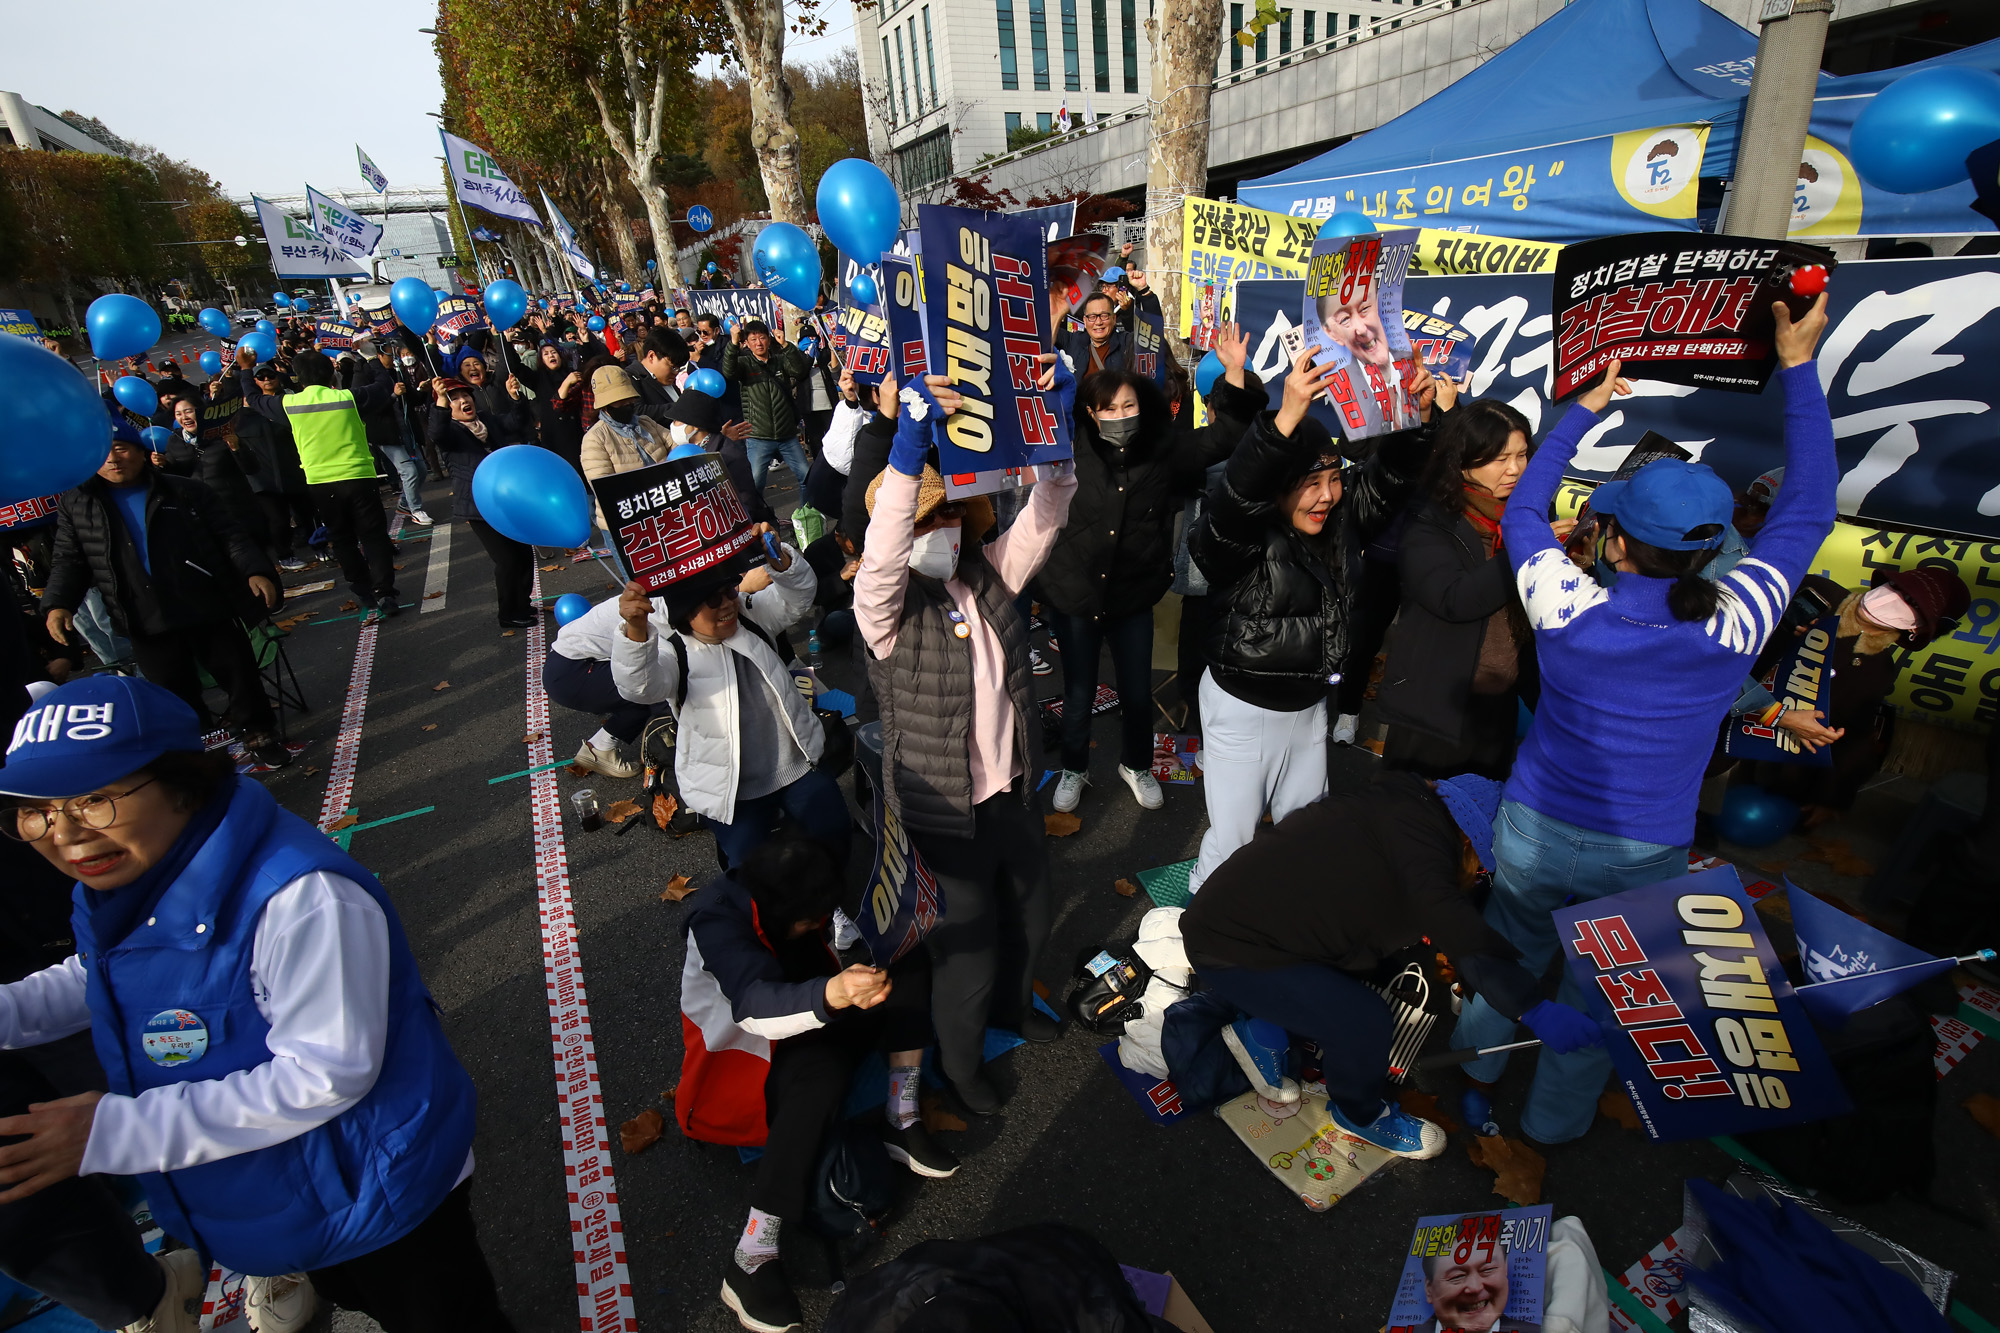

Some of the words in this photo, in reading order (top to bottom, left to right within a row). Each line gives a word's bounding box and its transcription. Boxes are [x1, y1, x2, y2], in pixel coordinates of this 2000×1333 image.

[1193, 203, 1271, 257] 검찰총장님
[1306, 251, 1345, 299] 비열한
[1341, 237, 1382, 305] 정적
[1374, 242, 1414, 289] 죽이기
[1570, 252, 1668, 299] 정치검찰
[947, 227, 994, 453] 이재명은
[1402, 309, 1470, 342] 재명은
[991, 253, 1059, 446] 무죄다!
[1570, 358, 1597, 386] 김건희
[1597, 343, 1648, 367] 수사검사
[1651, 344, 1680, 357] 전원
[1683, 342, 1749, 357] 탄핵하라!
[616, 478, 683, 520] 정치검찰
[685, 460, 723, 492] 탄핵하라!
[618, 478, 748, 574] 검찰해체
[649, 568, 676, 587] 김건희
[678, 552, 714, 575] 수사검사
[715, 543, 732, 559] 전원
[546, 874, 563, 905] DANGER!
[549, 905, 565, 922] 위험
[551, 930, 571, 967] 안전제일
[556, 967, 575, 1008] DANGER!
[1572, 914, 1735, 1100] 무죄다!
[1676, 894, 1801, 1109] 이재명은
[159, 1035, 182, 1043] 독도는
[560, 1009, 580, 1032] 위험
[170, 1041, 194, 1050] 우리땅!
[563, 1045, 588, 1095] 안전제일
[571, 1096, 596, 1153] DANGER!
[1247, 1120, 1273, 1140] pig
[577, 1155, 601, 1188] 위험
[584, 1208, 614, 1284] 안전제일
[1410, 1224, 1458, 1258] 비열한
[1453, 1212, 1503, 1266] 정적
[1499, 1214, 1548, 1254] 죽이기
